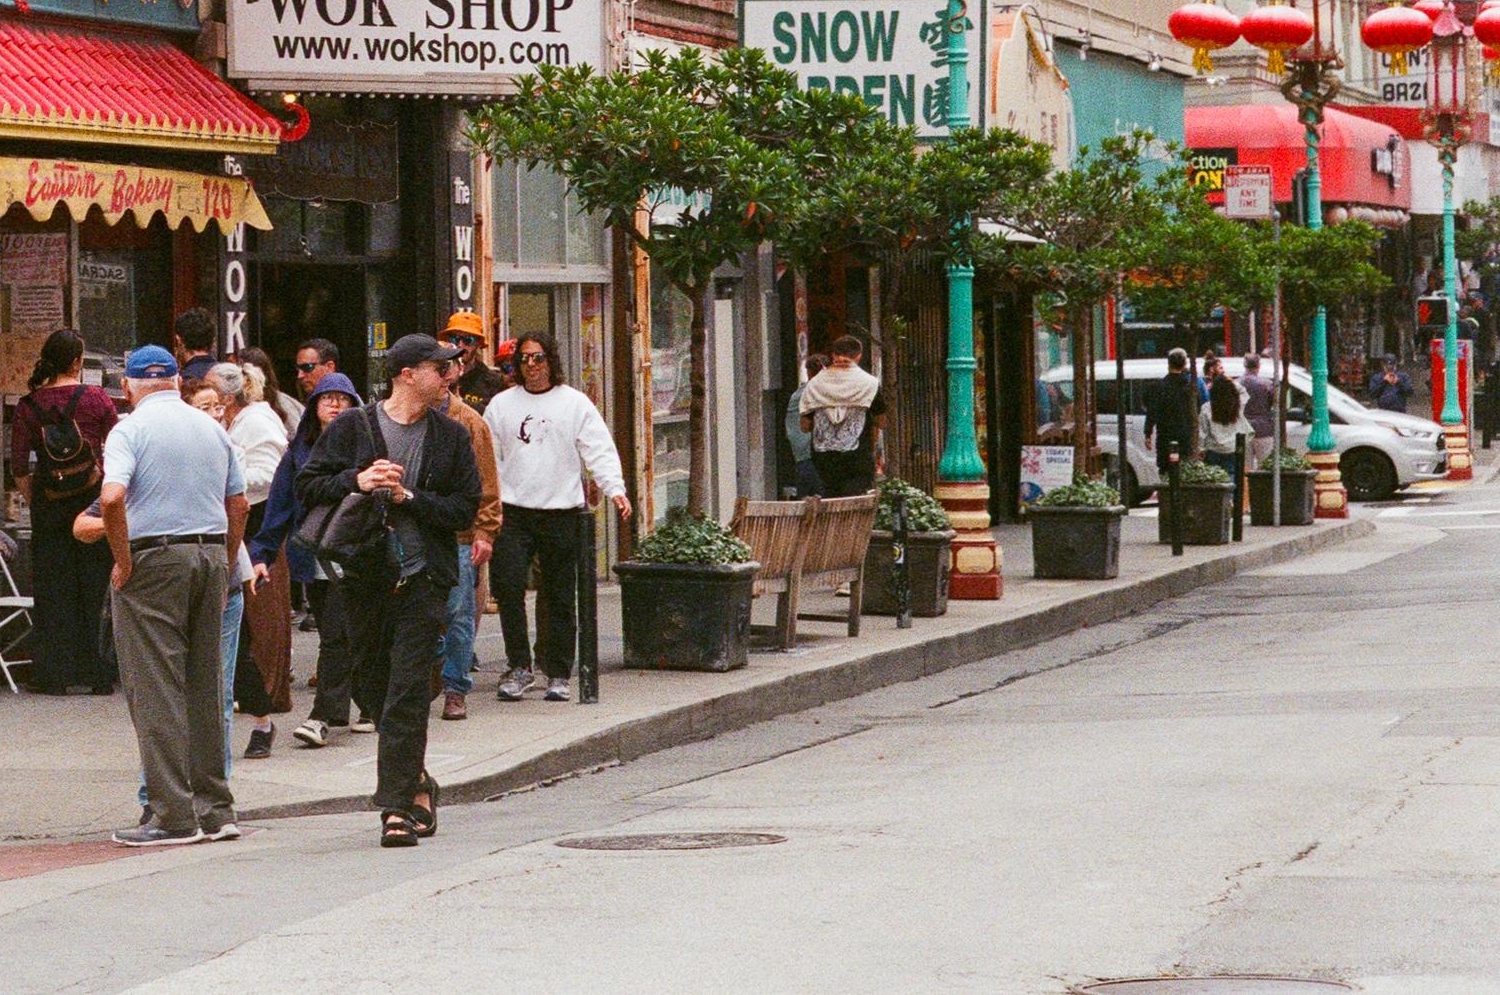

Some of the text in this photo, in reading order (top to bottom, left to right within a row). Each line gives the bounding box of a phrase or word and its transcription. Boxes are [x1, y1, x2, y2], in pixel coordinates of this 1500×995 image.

[273, 31, 571, 71] www.wokshop.com
[772, 10, 900, 64] SNOW
[25, 160, 104, 208] Eastern
[111, 167, 173, 215] Bakery
[201, 179, 233, 220] 720
[454, 175, 471, 205] the
[455, 225, 473, 312] WO
